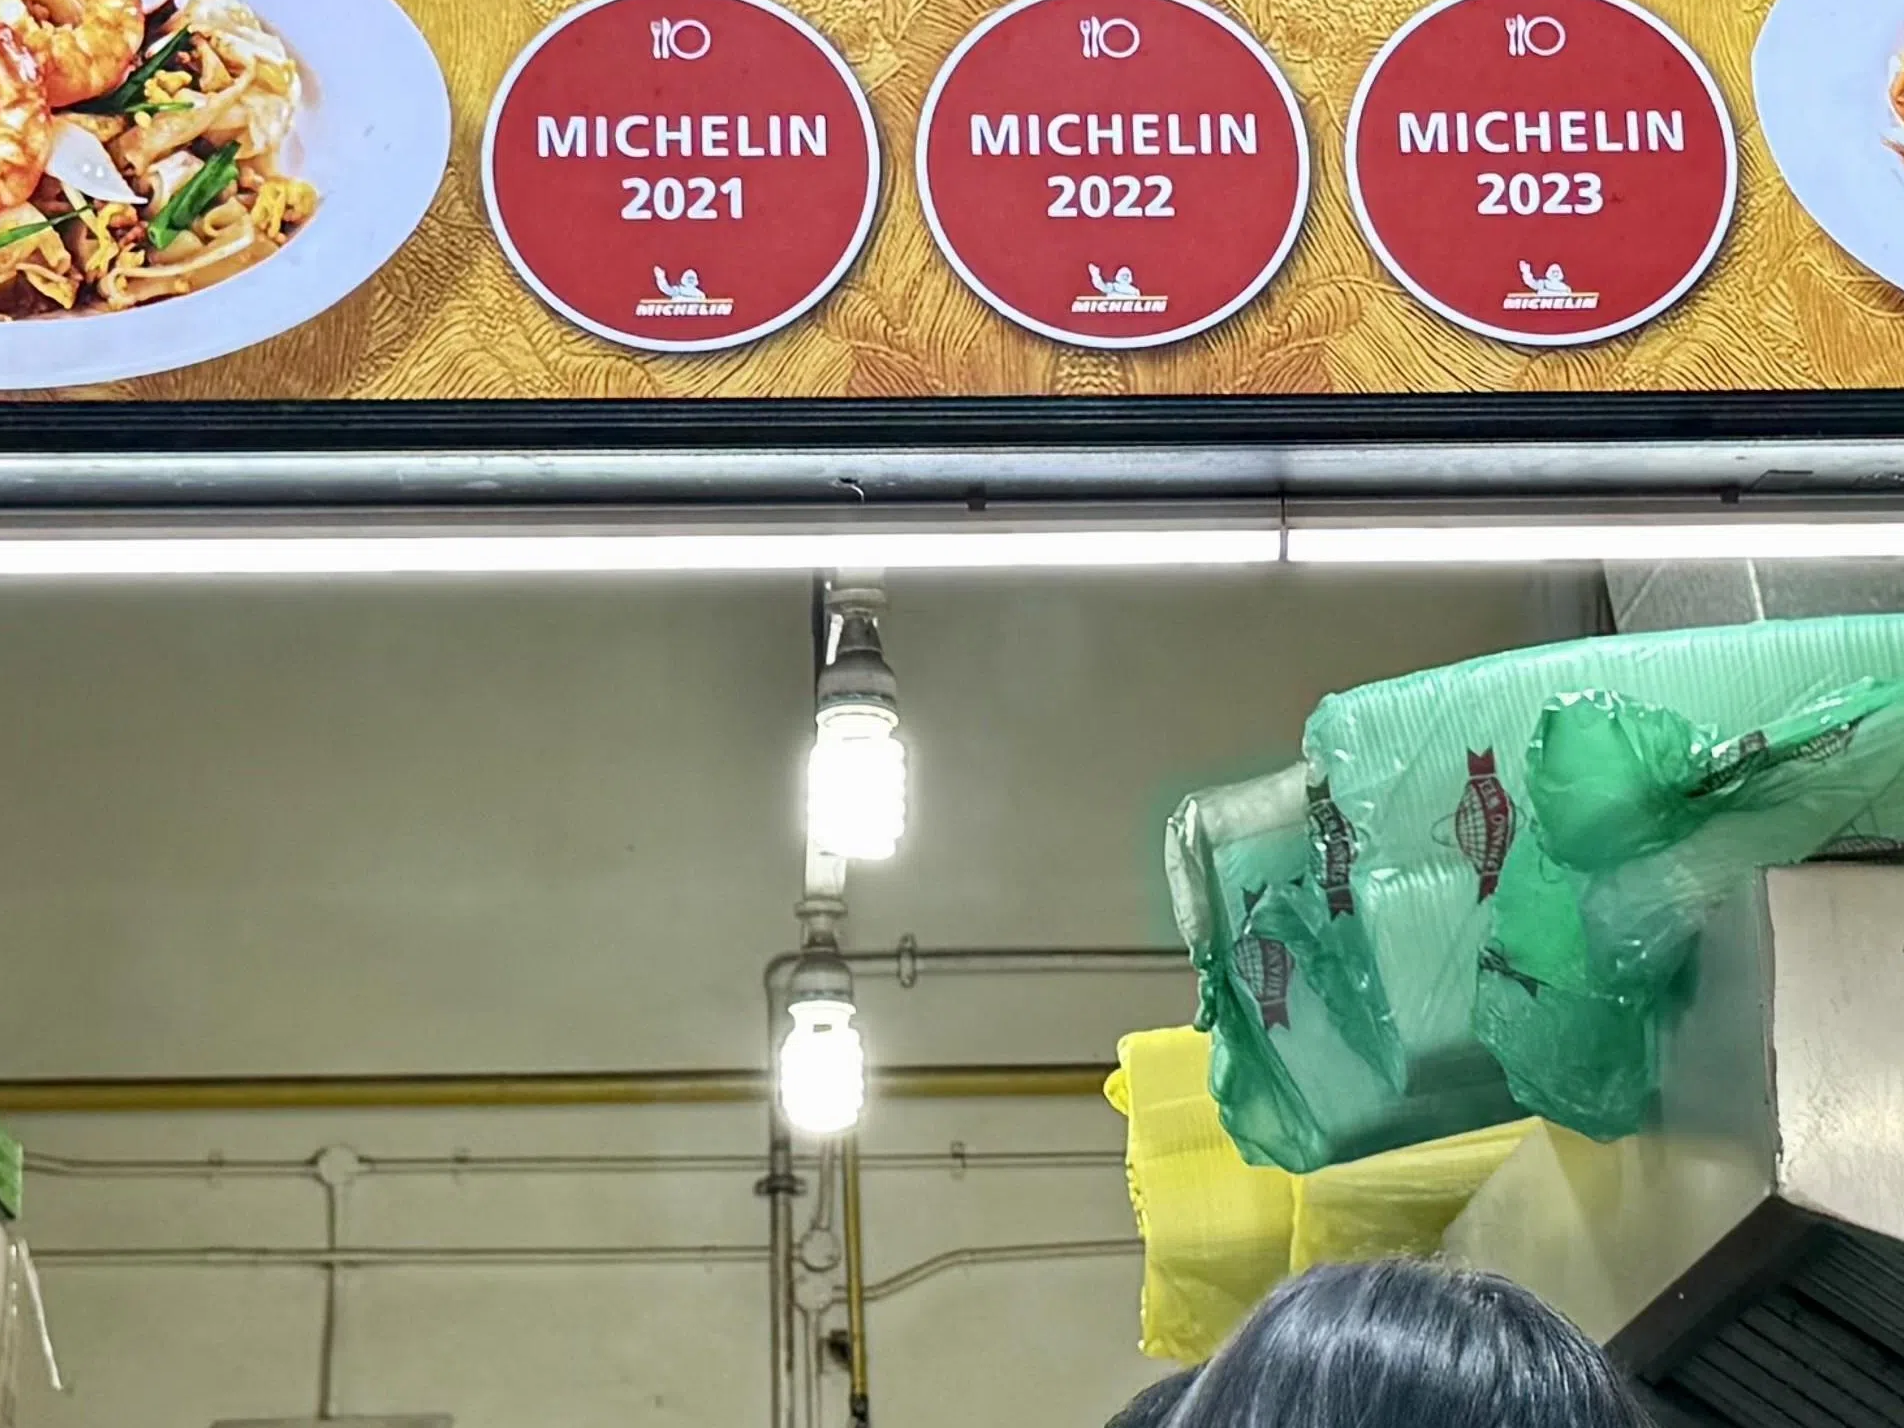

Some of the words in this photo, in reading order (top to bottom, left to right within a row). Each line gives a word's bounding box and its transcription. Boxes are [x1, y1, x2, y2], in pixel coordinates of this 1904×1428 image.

[535, 114, 828, 159] MICHELIN
[968, 112, 1259, 157] MICHELIN
[1398, 109, 1686, 154] MICHELIN
[621, 175, 745, 221] 2021
[1046, 174, 1175, 220] 2022
[1475, 172, 1604, 218] 2023
[636, 301, 733, 316] MICHELIN
[1071, 299, 1168, 314] MICHELIN
[1502, 296, 1599, 310] MICHELIN
